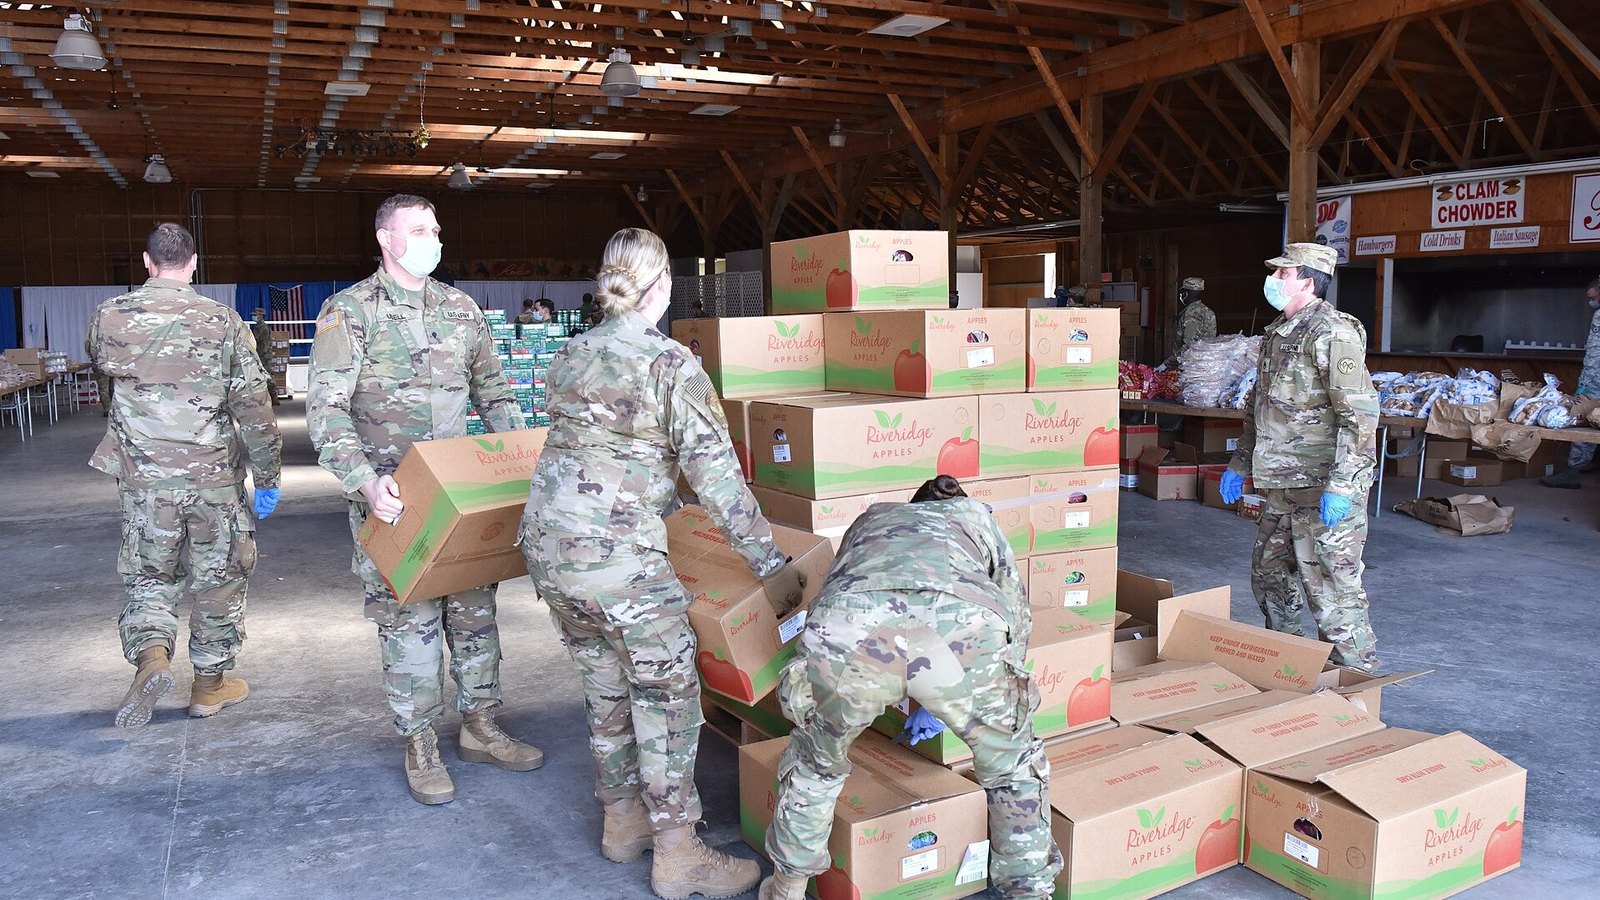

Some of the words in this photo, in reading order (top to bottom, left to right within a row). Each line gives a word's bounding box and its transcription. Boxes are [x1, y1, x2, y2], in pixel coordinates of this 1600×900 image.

[1456, 180, 1500, 200] CLAM
[1438, 200, 1517, 223] CHOWDER
[1423, 234, 1438, 247] Cold
[1439, 233, 1461, 246] Drinks
[1494, 230, 1513, 242] Italian
[1514, 229, 1538, 244] Sausage
[855, 241, 880, 251] Riveridge
[1358, 240, 1394, 252] Hamburgers
[791, 252, 823, 276] Riveridge
[929, 321, 956, 332] Riveridge
[1034, 320, 1059, 330] Riveridge
[768, 330, 825, 354] Riveridge
[850, 329, 890, 355] Riveridge
[774, 355, 809, 363] APPLES
[1025, 409, 1082, 435] Riveridge
[867, 420, 932, 447] Riveridge
[1030, 435, 1064, 444] APPLES
[475, 444, 538, 466] Riveridge
[873, 448, 912, 459] APPLES
[494, 465, 532, 476] APPLES
[817, 510, 847, 521] Riveridge
[1033, 565, 1056, 575] Riveridge
[729, 611, 759, 637] Riveridge
[1209, 635, 1222, 643] KEEP
[1223, 638, 1240, 648] UNDER
[1241, 643, 1280, 657] REFRIGERATION
[1214, 645, 1235, 656] WASHED
[1236, 651, 1247, 659] AND
[1247, 654, 1266, 663] WAXED
[1273, 670, 1309, 687] Riveridge
[1266, 722, 1282, 731] UNDER
[1282, 712, 1318, 726] REFRIGERATION
[1336, 713, 1369, 728] Riveridge
[1270, 728, 1291, 738] WASHED
[1302, 721, 1318, 729] WAXED
[1186, 758, 1223, 774] Riveridge
[1470, 758, 1506, 773] Riveridge
[1251, 786, 1282, 808] Riveridge
[909, 813, 936, 828] APPLES
[858, 830, 893, 847] Riveridge
[1126, 811, 1194, 851] Riveridge
[1424, 812, 1483, 852] Riveridge
[1131, 845, 1171, 866] APPLES
[1428, 846, 1464, 867] APPLES
